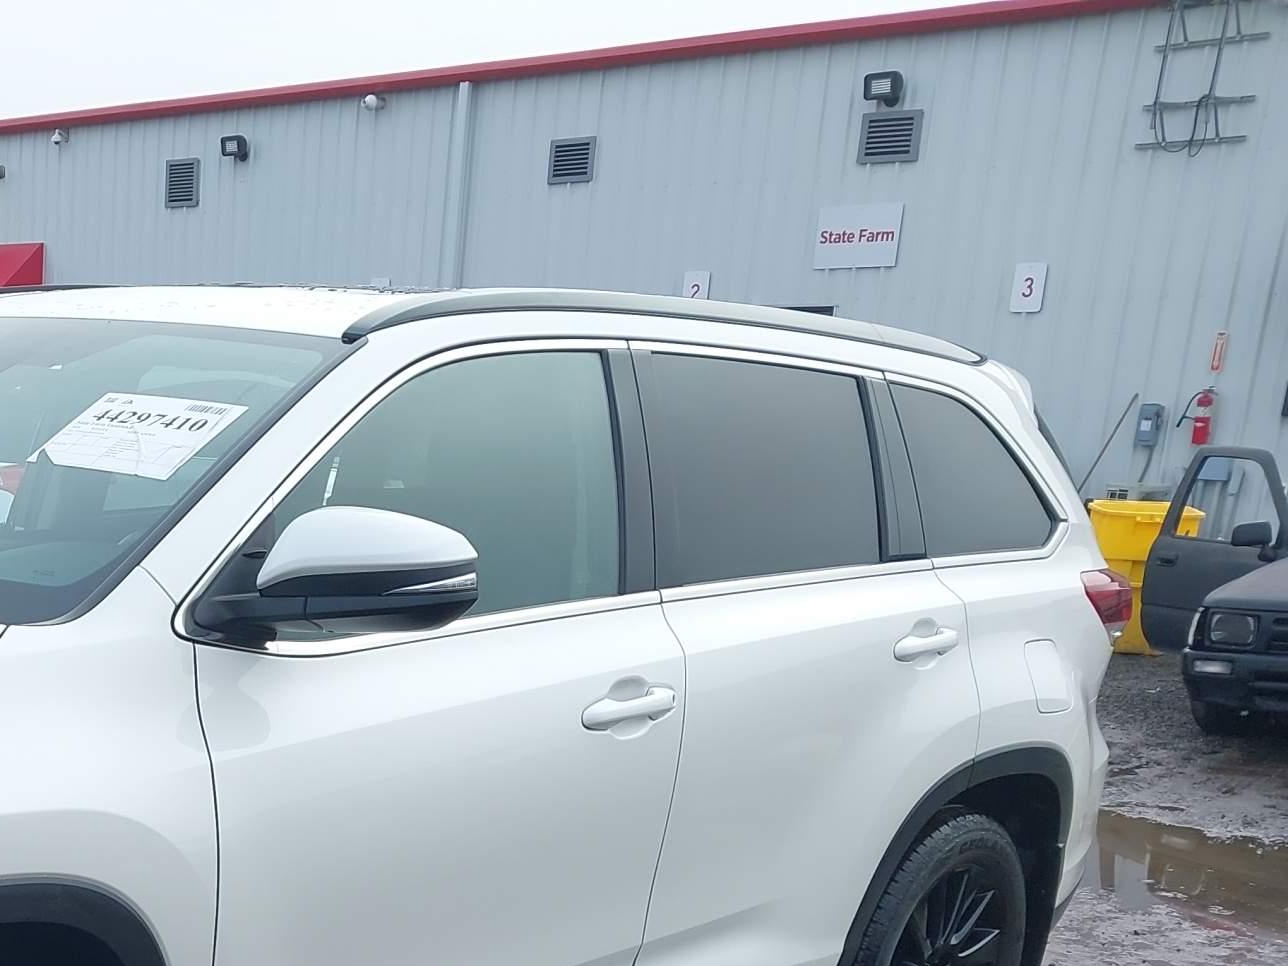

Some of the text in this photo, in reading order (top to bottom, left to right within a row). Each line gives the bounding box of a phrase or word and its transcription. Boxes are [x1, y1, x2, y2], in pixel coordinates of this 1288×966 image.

[819, 225, 895, 244] State Farm
[690, 283, 701, 298] 2
[1022, 276, 1034, 298] 3
[92, 408, 209, 432] 44297410
